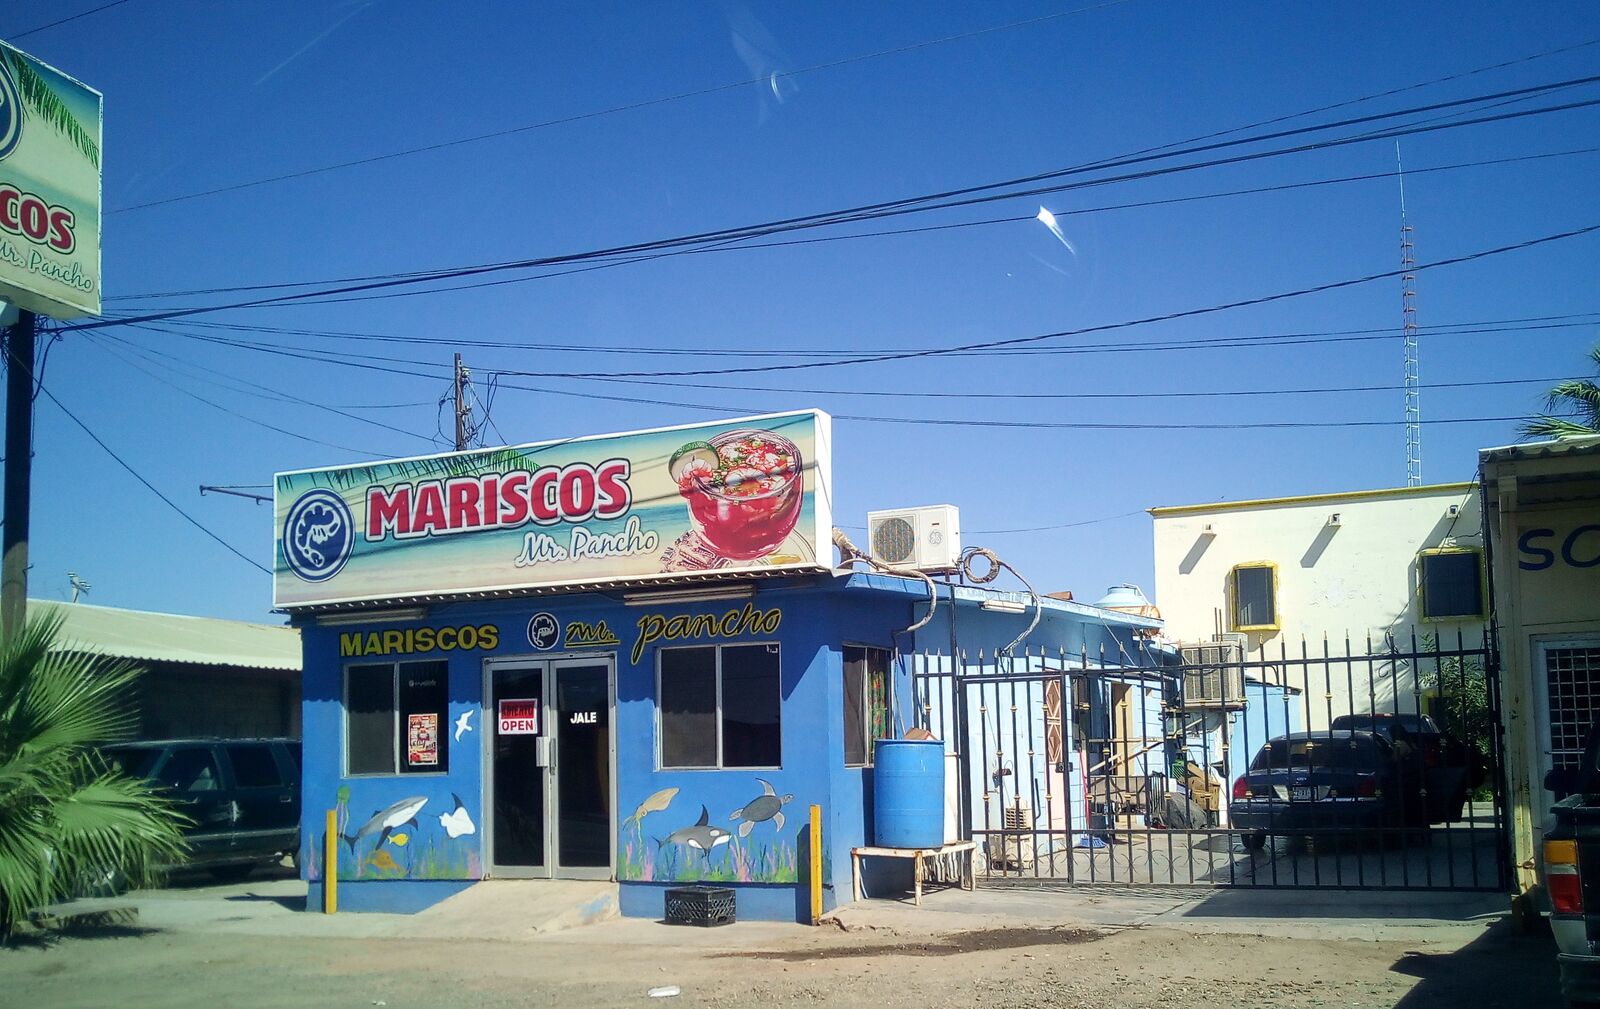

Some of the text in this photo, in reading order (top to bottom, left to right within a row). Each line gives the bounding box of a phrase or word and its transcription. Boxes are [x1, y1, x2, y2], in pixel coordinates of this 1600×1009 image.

[0, 241, 93, 290] r. Pancho
[367, 462, 630, 539] MARISCOS
[516, 516, 658, 567] Mr. Pancho
[339, 624, 499, 657] MARISCOS
[631, 602, 782, 665] pancho
[502, 720, 534, 731] OPEN
[570, 711, 597, 724] JALE
